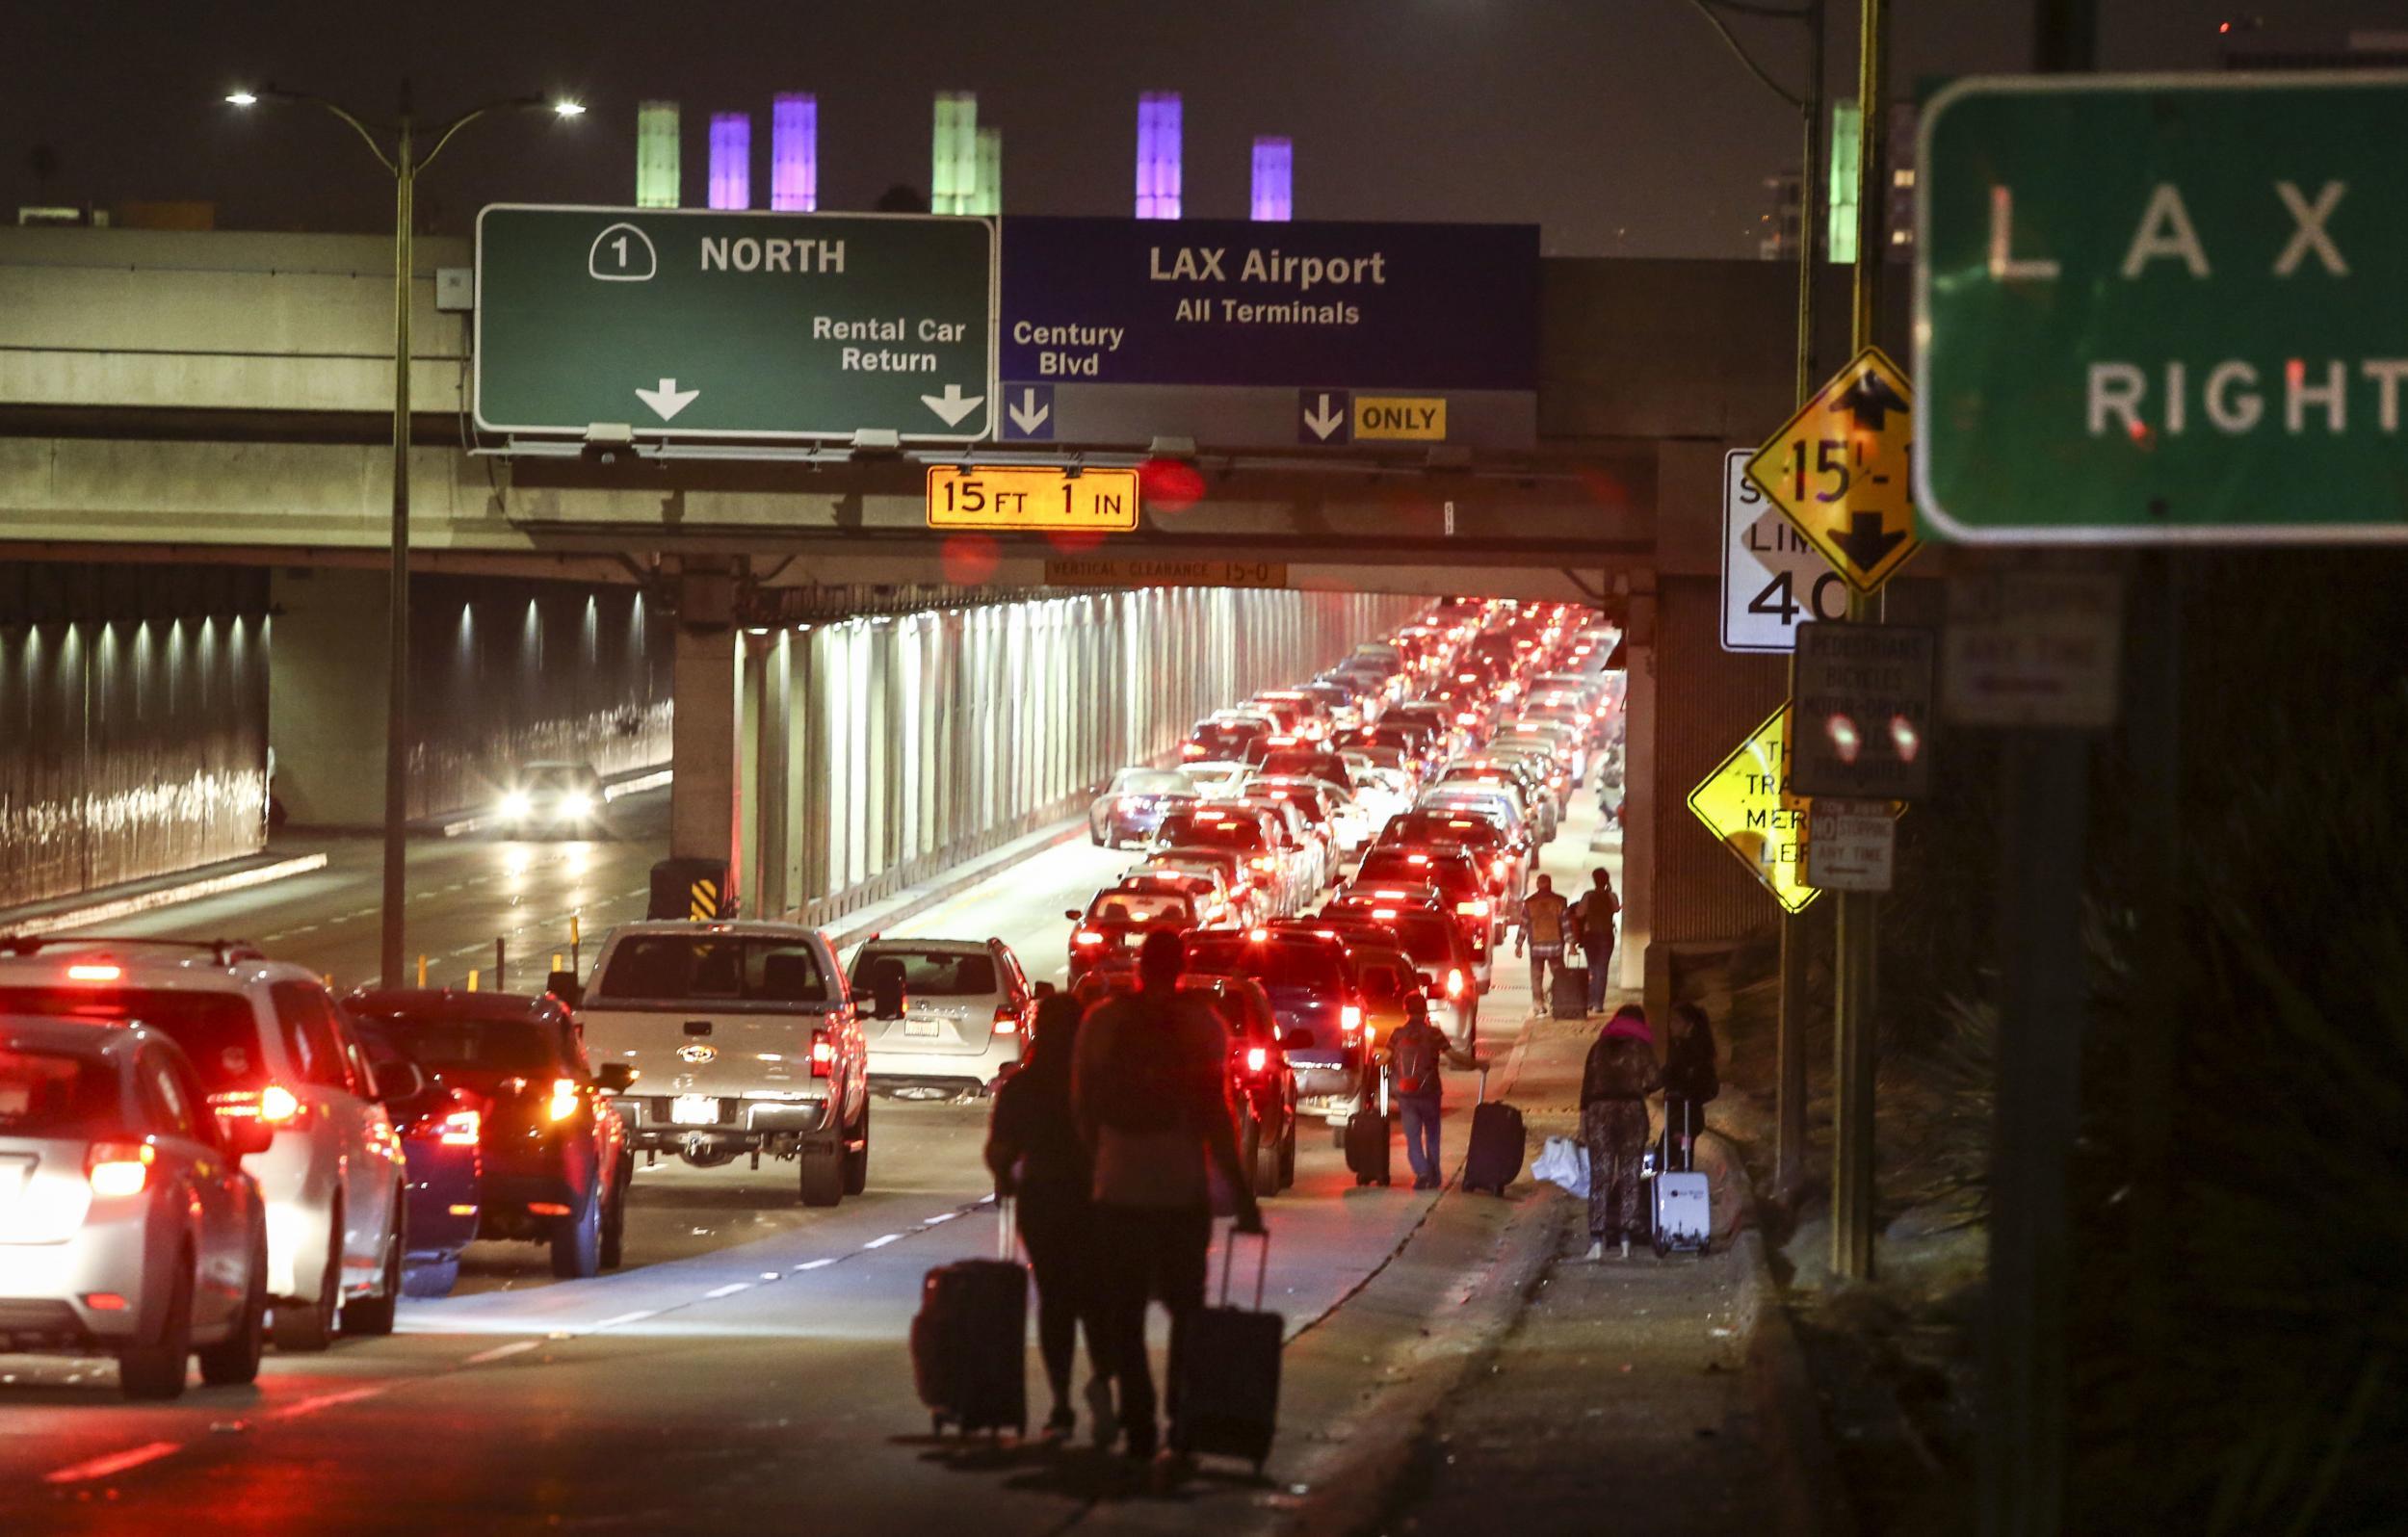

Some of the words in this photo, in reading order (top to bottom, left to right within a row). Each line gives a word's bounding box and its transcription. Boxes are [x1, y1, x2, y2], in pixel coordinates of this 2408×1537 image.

[611, 236, 628, 268] 1
[700, 237, 846, 274] NORTH
[1150, 247, 1227, 281] LAX
[1241, 249, 1386, 291] Airport
[1175, 299, 1211, 324] All
[1221, 299, 1360, 326] Terminals
[813, 316, 905, 342] Rental
[918, 319, 966, 343] Car
[1013, 321, 1125, 352] Century
[842, 348, 937, 373] Return
[1039, 352, 1100, 377] Blvd
[2085, 357, 2408, 439] RIGHT
[1362, 405, 1436, 430] ONLY
[943, 481, 986, 513] 15
[994, 491, 1029, 514] FT
[1060, 482, 1073, 514] 1
[1094, 493, 1122, 515] IN
[1054, 561, 1116, 578] VERTICAL
[1129, 562, 1210, 579] CLEARANCE
[1225, 562, 1269, 583] 15-0
[1746, 808, 1808, 830] MER
[1819, 846, 1845, 861] ANY
[1851, 847, 1885, 862] TIME
